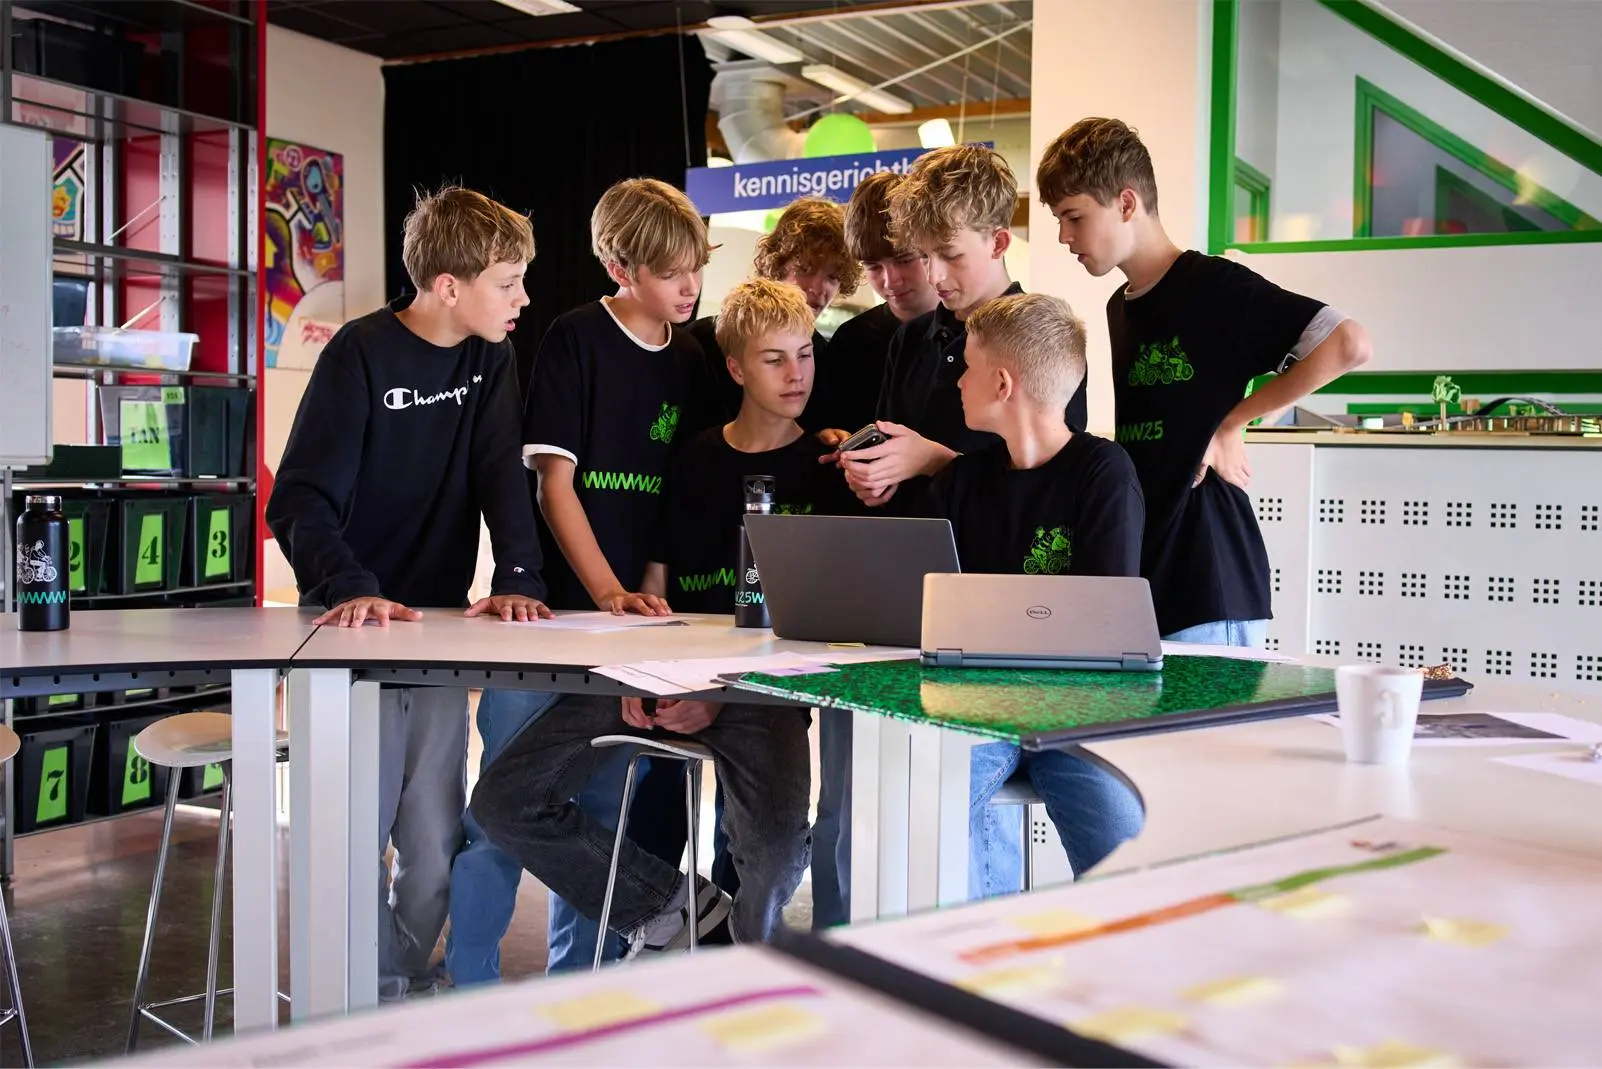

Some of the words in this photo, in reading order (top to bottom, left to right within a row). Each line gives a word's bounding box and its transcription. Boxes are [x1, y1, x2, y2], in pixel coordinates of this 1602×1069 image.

[69, 540, 81, 573] 2
[141, 536, 161, 566] 4
[212, 530, 228, 559] 3
[46, 769, 65, 801] 7
[129, 755, 148, 785] 8
